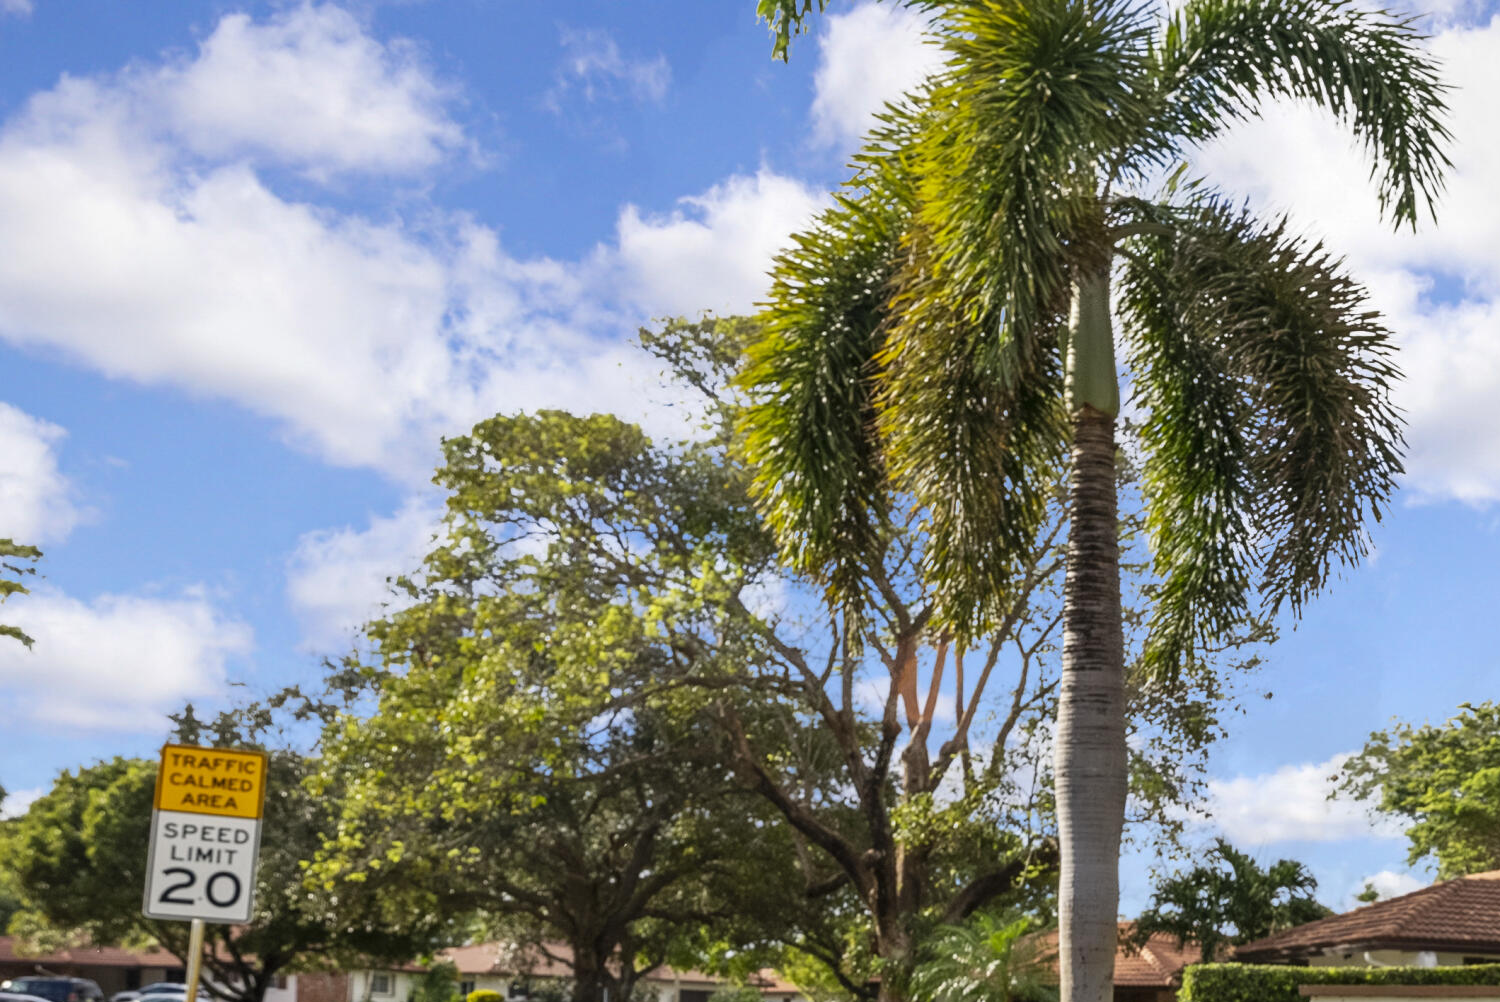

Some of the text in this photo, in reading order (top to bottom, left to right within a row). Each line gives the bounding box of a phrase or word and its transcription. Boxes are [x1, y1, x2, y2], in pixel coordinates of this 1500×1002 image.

[170, 753, 257, 775] TRAFFIC
[169, 772, 253, 793] CALMED
[180, 792, 238, 809] AREA
[163, 822, 250, 845] SPEED
[170, 845, 238, 865] LIMIT
[158, 867, 242, 908] 20
